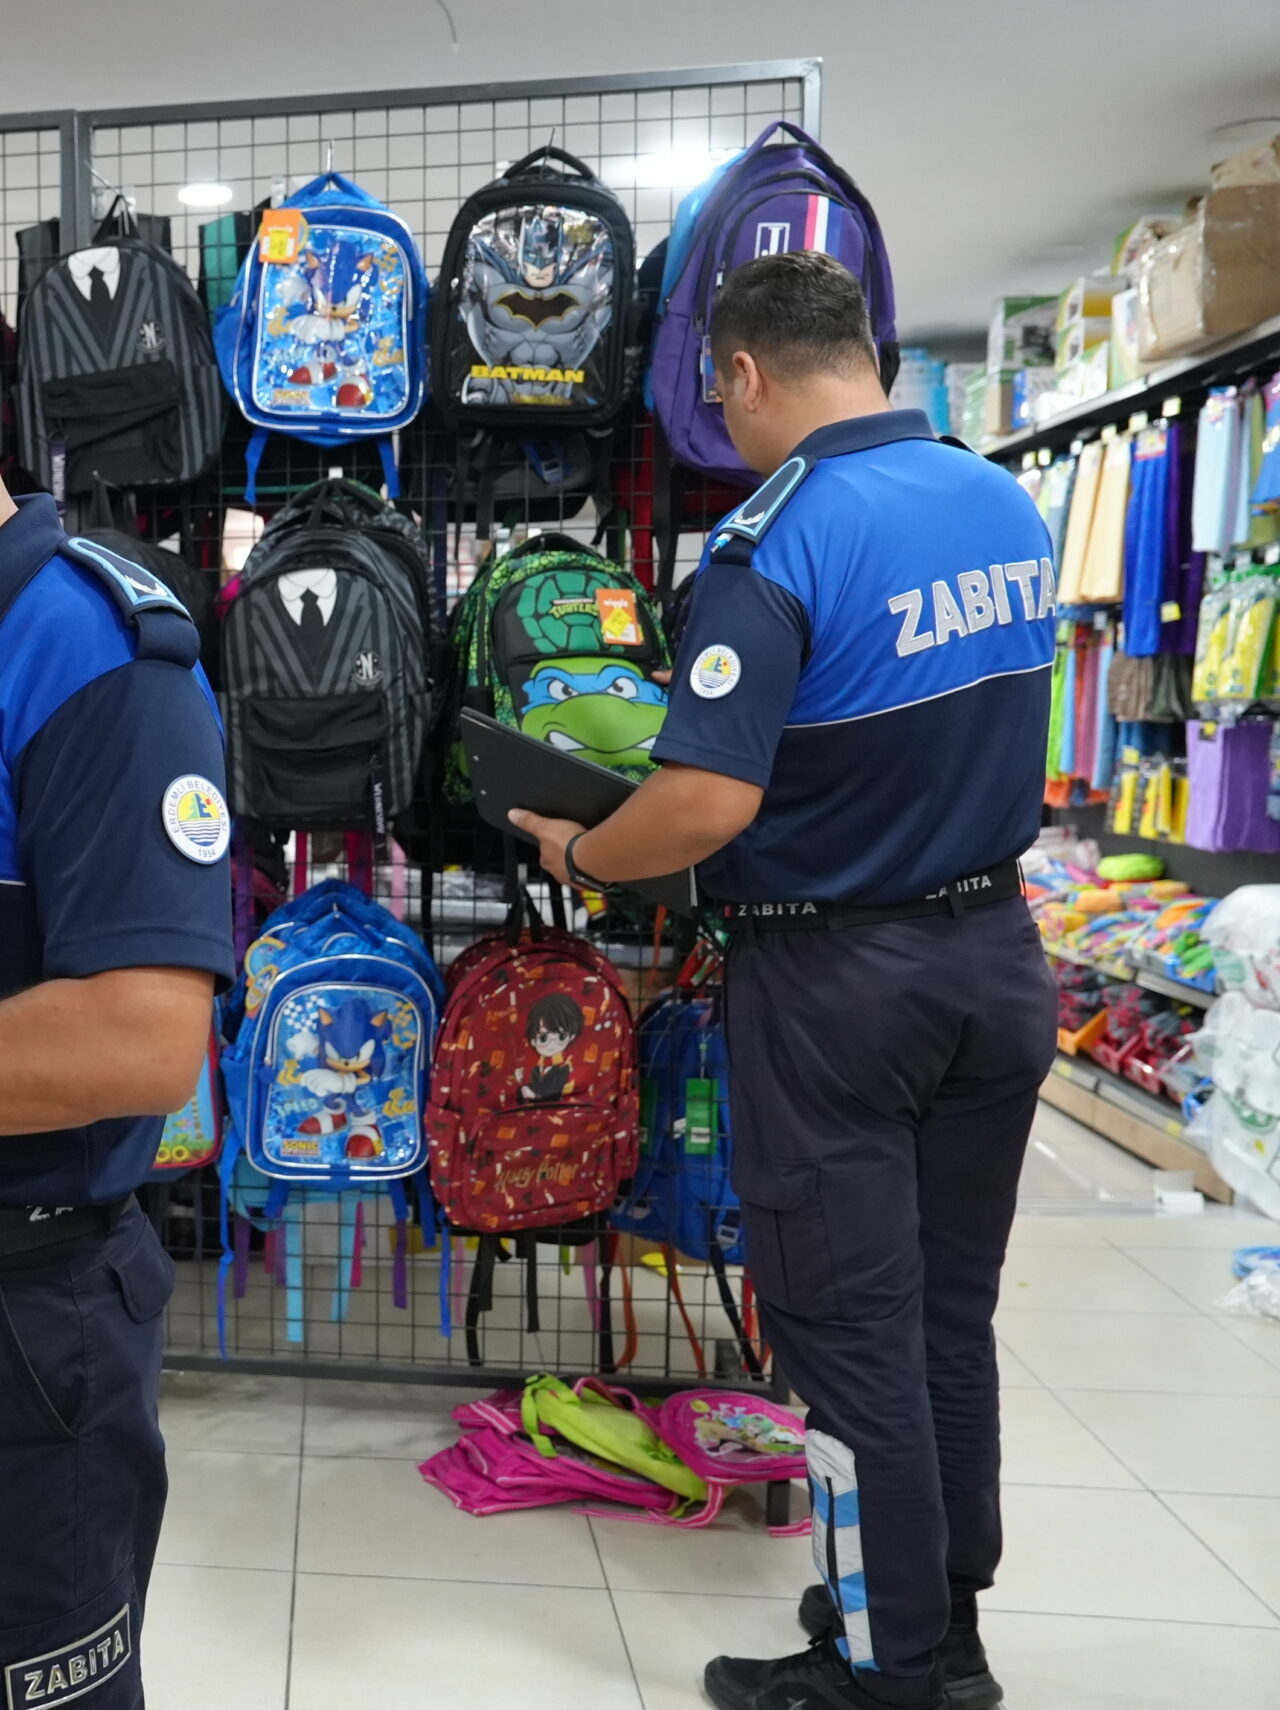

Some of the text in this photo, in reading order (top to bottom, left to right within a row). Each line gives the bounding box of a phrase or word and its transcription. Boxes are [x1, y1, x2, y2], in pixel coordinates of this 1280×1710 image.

[471, 365, 585, 383] BATMAN
[888, 557, 1056, 658] ZABITA
[198, 848, 216, 858] 1954
[24, 1629, 124, 1701] ZABITA
